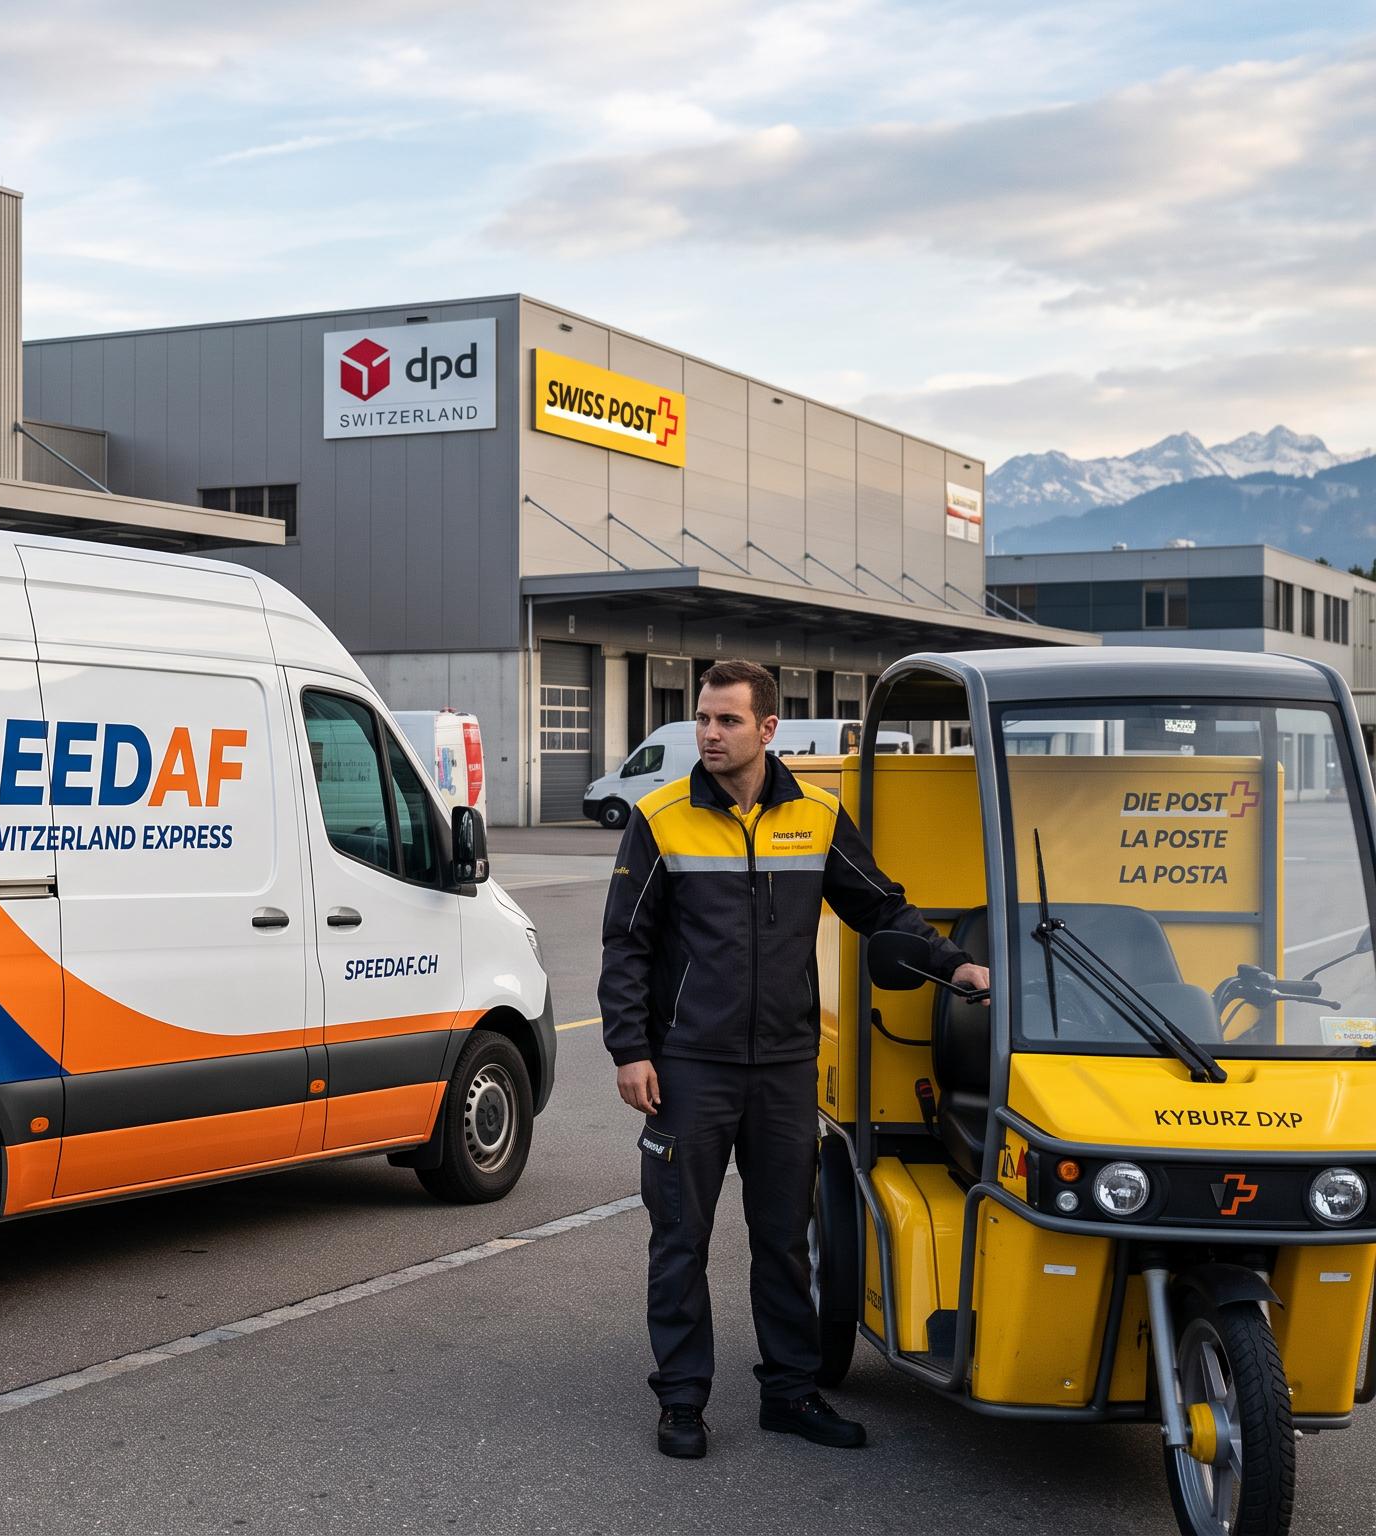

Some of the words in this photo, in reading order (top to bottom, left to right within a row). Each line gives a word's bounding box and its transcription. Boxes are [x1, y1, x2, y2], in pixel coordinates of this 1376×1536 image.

[405, 342, 478, 390] dpd
[339, 405, 478, 428] SWITZERLAND
[546, 380, 605, 420] SWISS
[608, 397, 657, 434] POST
[1123, 792, 1162, 812] DIE
[1165, 792, 1228, 812] POST
[142, 824, 233, 850] EXPRESS
[1120, 829, 1149, 848] LA
[1154, 829, 1228, 849] POSTE
[1119, 865, 1147, 884] LA
[1153, 865, 1228, 884] POSTA
[344, 954, 439, 981] SPEEDAF.CH
[1154, 1110, 1251, 1127] KYBURZ
[1256, 1111, 1303, 1128] DXP
